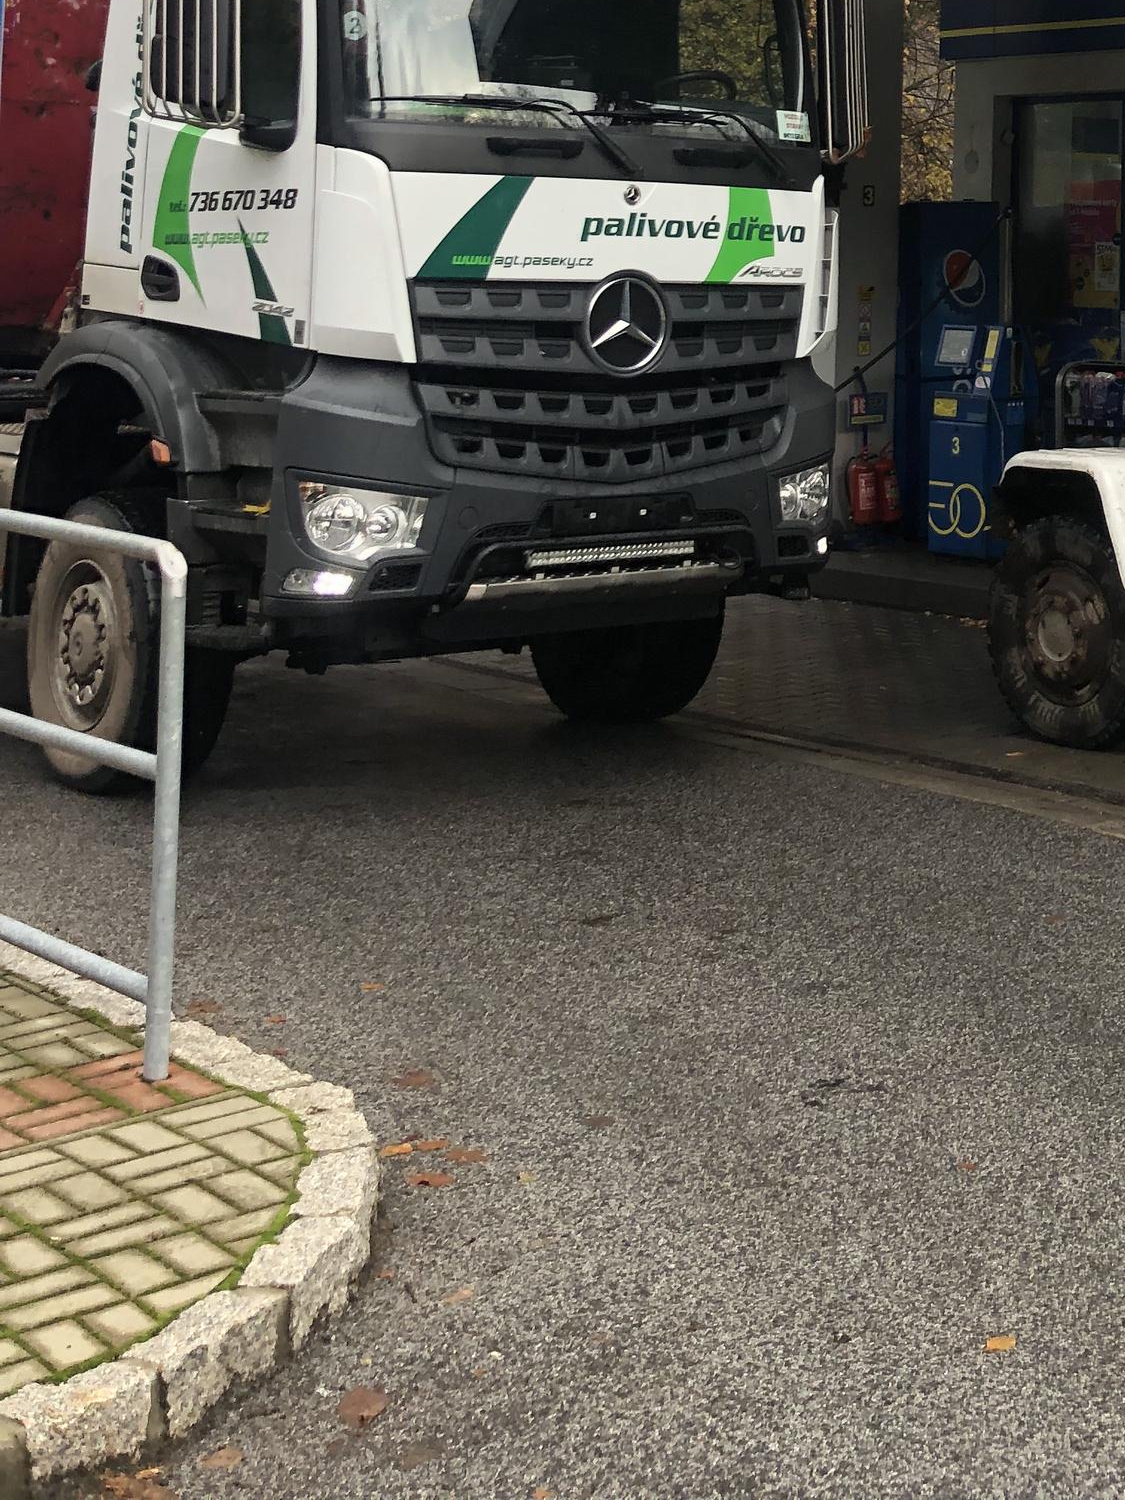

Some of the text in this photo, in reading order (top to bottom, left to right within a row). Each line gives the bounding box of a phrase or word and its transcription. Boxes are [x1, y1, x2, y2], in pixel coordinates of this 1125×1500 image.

[189, 191, 220, 212] 736
[221, 189, 256, 211] 670
[257, 188, 299, 210] 348
[864, 187, 874, 205] 3
[580, 212, 806, 243] palivové dřevo
[951, 436, 960, 455] 3
